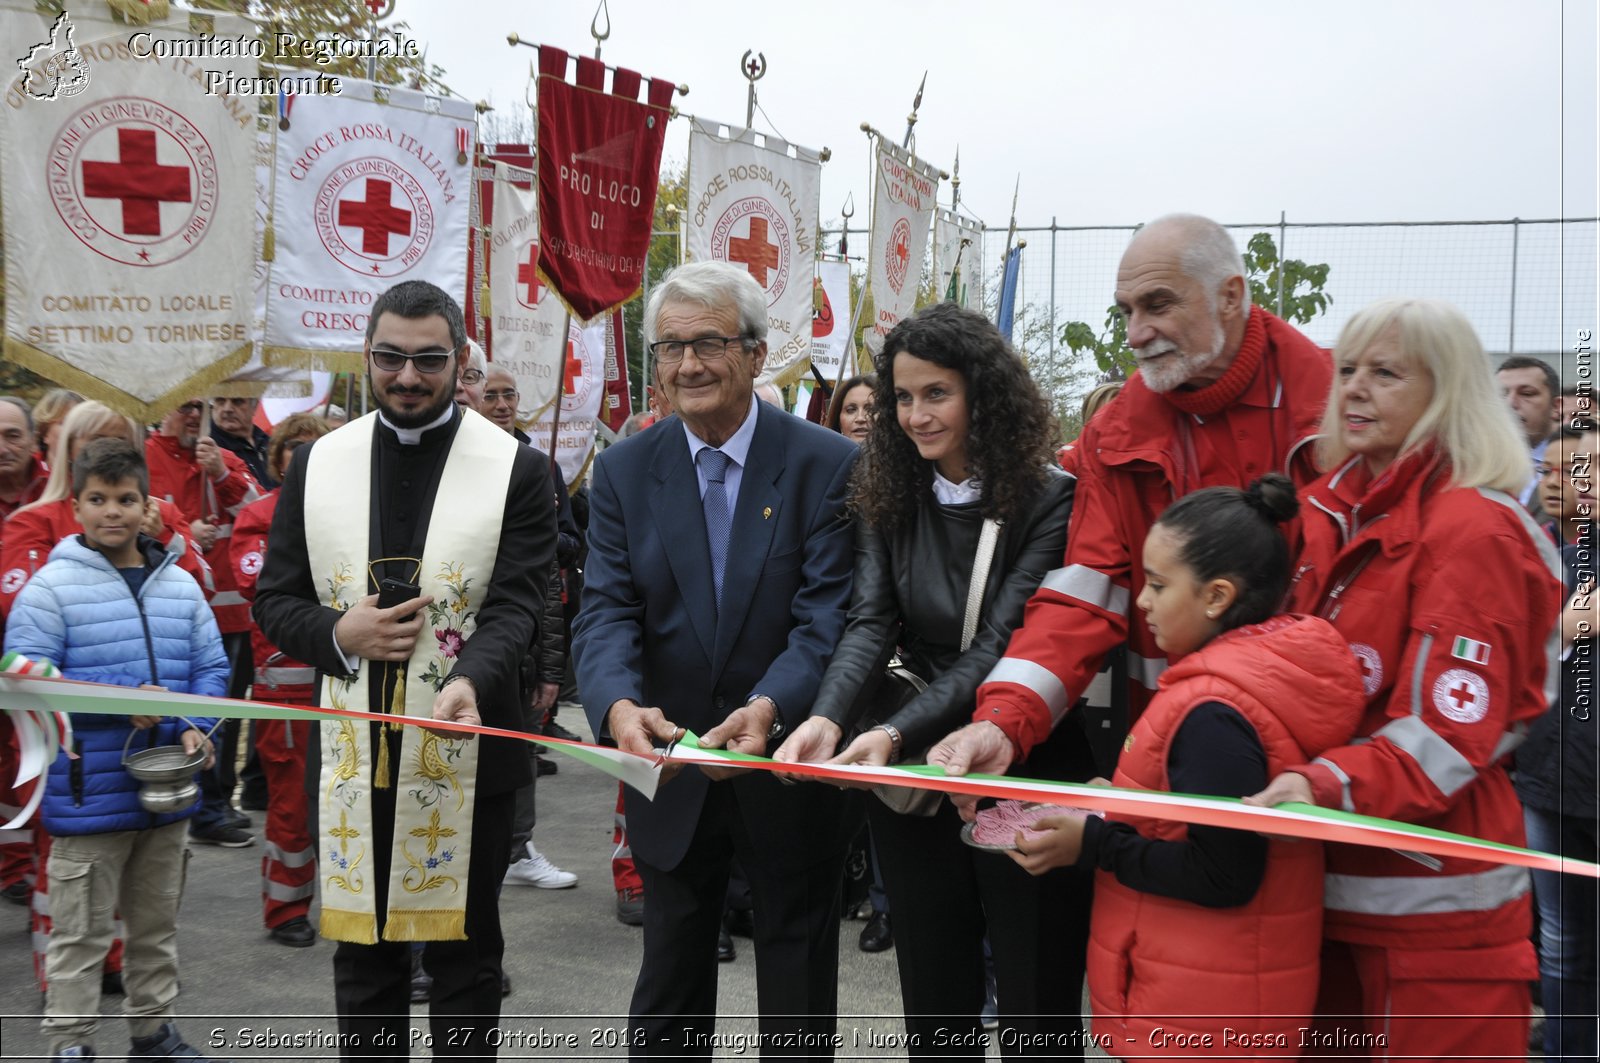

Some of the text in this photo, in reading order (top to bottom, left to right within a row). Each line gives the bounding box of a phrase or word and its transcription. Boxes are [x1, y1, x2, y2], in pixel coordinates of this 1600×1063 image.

[80, 111, 100, 129] DI
[100, 102, 174, 128] GINEVRA
[174, 123, 196, 145] 22
[289, 131, 340, 182] CROCE
[339, 123, 394, 143] ROSSA
[397, 132, 457, 205] ITALIANA
[341, 166, 356, 179] DI
[356, 160, 405, 183] GINEVRA
[404, 180, 419, 196] 22
[560, 164, 641, 208] PRO LOCO
[694, 164, 810, 254] CROCE ROSSA ITALIANA
[414, 195, 431, 245] AGOSTO
[591, 211, 604, 231] DI
[401, 246, 421, 266] 1864
[714, 200, 790, 298] ENZIONE DI GINEVRA 22 AGOSTO 1864
[42, 295, 232, 312] COMITATO LOCALE
[280, 284, 372, 305] COMITATO
[301, 310, 372, 332] CRESC
[767, 316, 790, 334] OCALE
[27, 325, 134, 344] SETTIMO
[144, 323, 247, 343] TORINESE
[524, 340, 536, 352] DI
[765, 335, 807, 367] ORINESE
